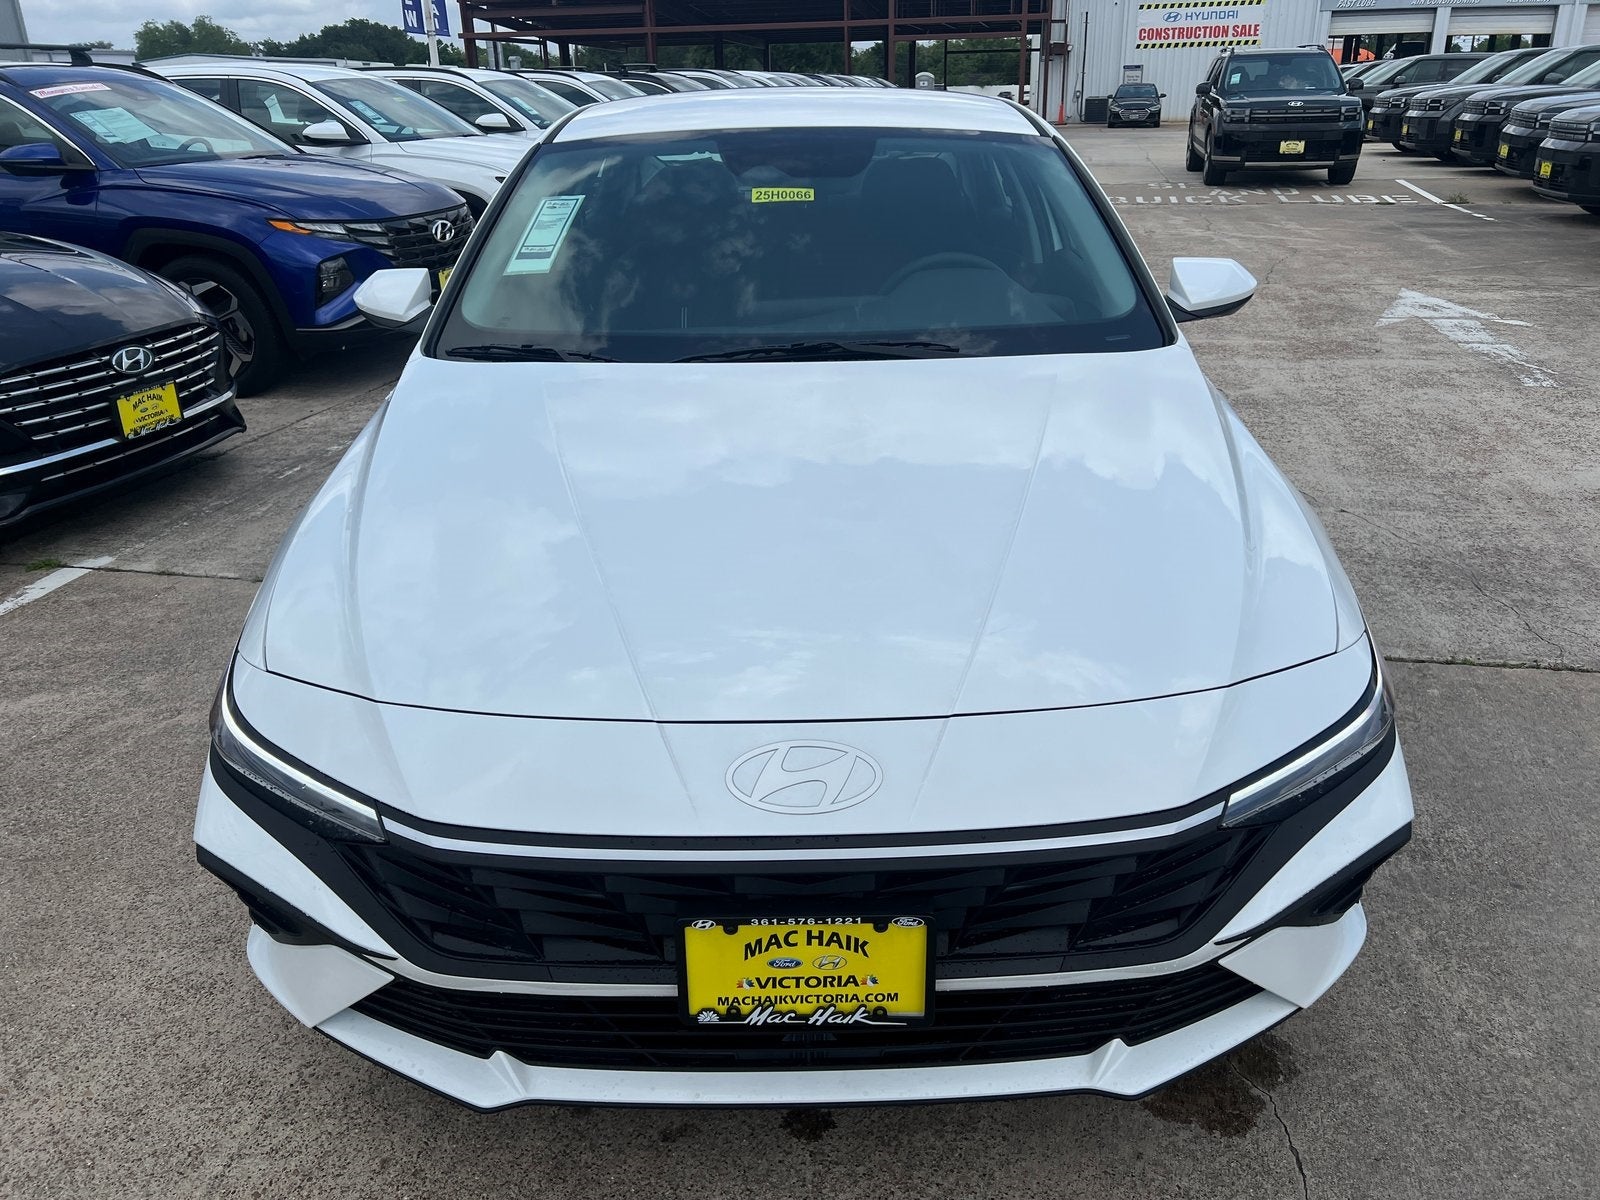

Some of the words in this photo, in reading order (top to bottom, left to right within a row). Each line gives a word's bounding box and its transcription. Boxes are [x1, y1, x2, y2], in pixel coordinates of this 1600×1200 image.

[1185, 10, 1239, 21] HYUNDAI
[1138, 26, 1230, 41] CONSTRUCTION
[1231, 24, 1260, 38] SALE
[755, 190, 811, 201] 25H0066
[1276, 194, 1418, 204] LUBE
[132, 395, 146, 410] MAC
[750, 918, 862, 926] 361-576-1221
[744, 930, 798, 960] MAC
[806, 930, 869, 958] HAIK
[755, 975, 860, 989] VICTORIA
[717, 992, 899, 1006] MACHAIKVICTORIA.COM
[745, 1005, 804, 1026] Mac
[808, 1005, 875, 1026] Haik
